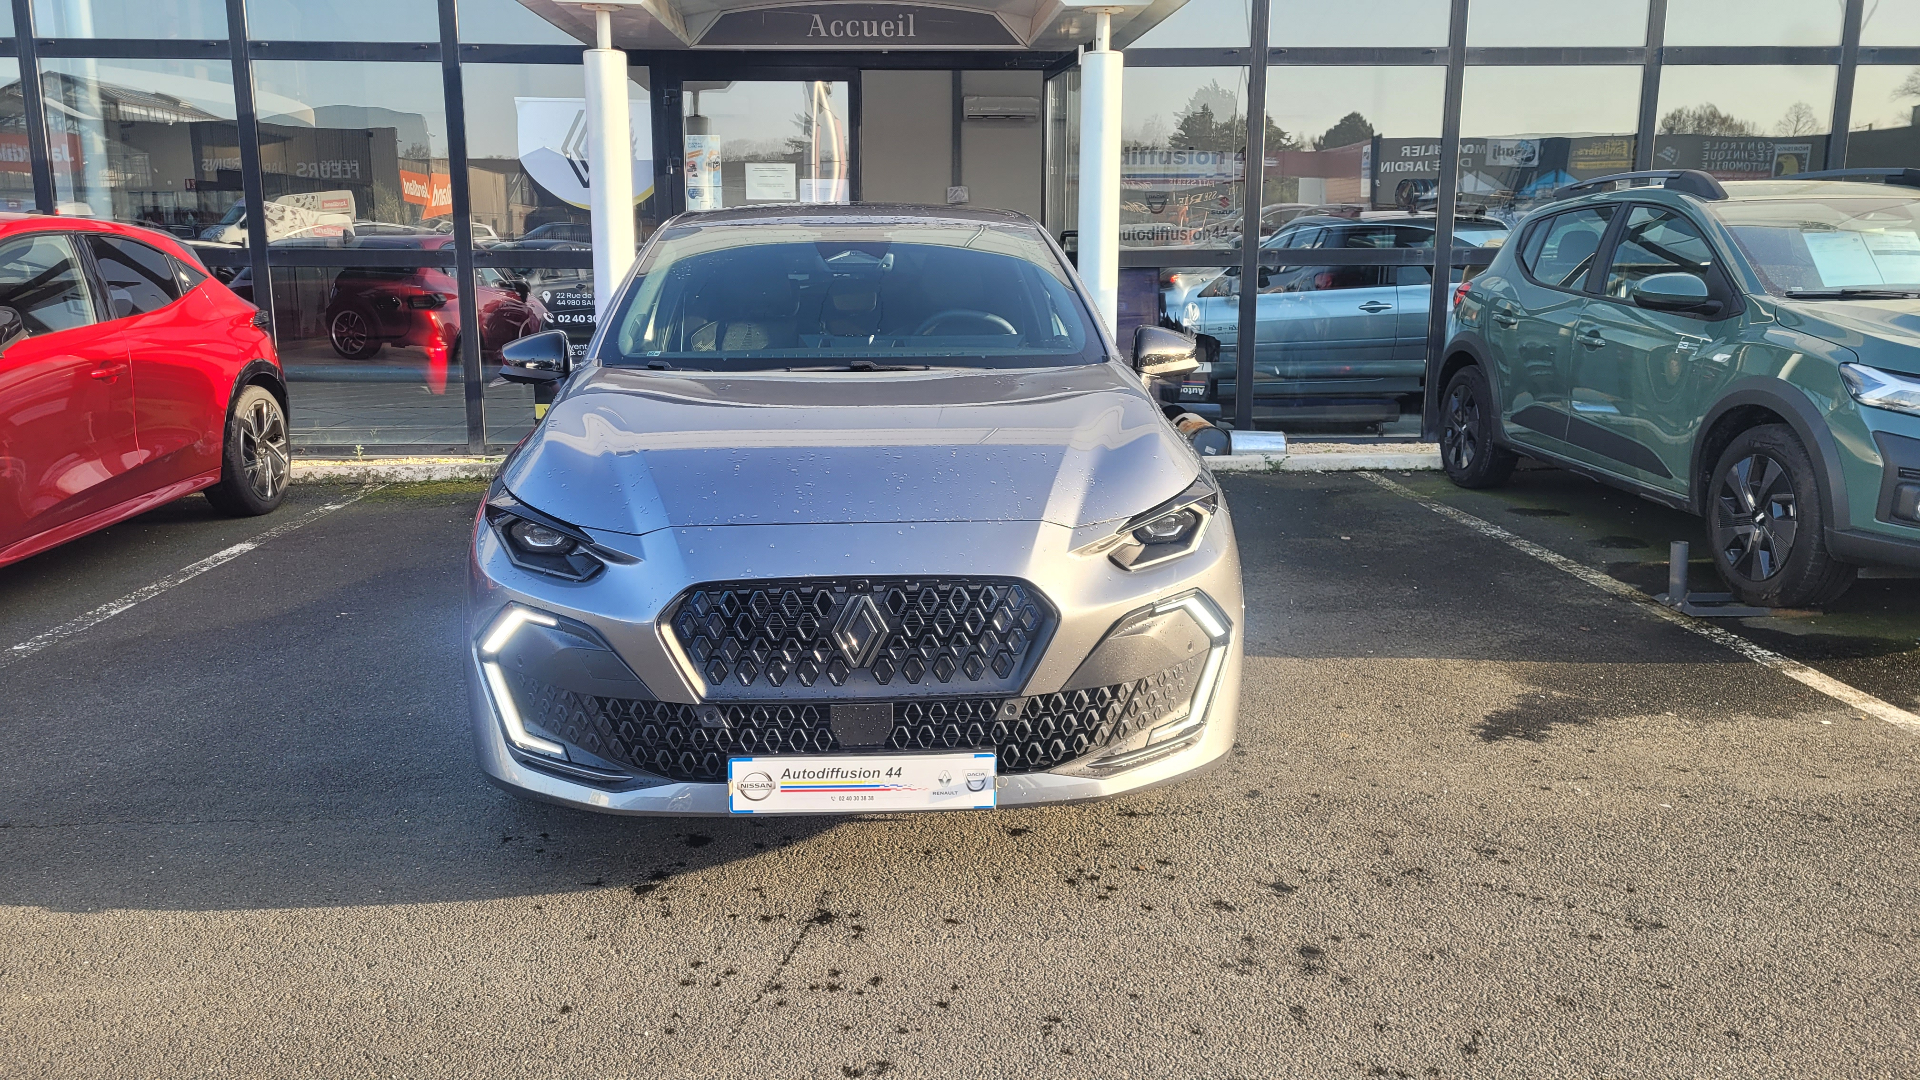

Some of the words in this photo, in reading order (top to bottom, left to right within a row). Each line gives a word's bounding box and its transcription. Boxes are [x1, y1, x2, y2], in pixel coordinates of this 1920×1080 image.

[806, 13, 916, 38] Accueil
[582, 291, 592, 299] de
[557, 314, 571, 323] 02
[572, 314, 586, 323] 40
[780, 767, 881, 780] Autodiffusion
[885, 766, 903, 779] 44
